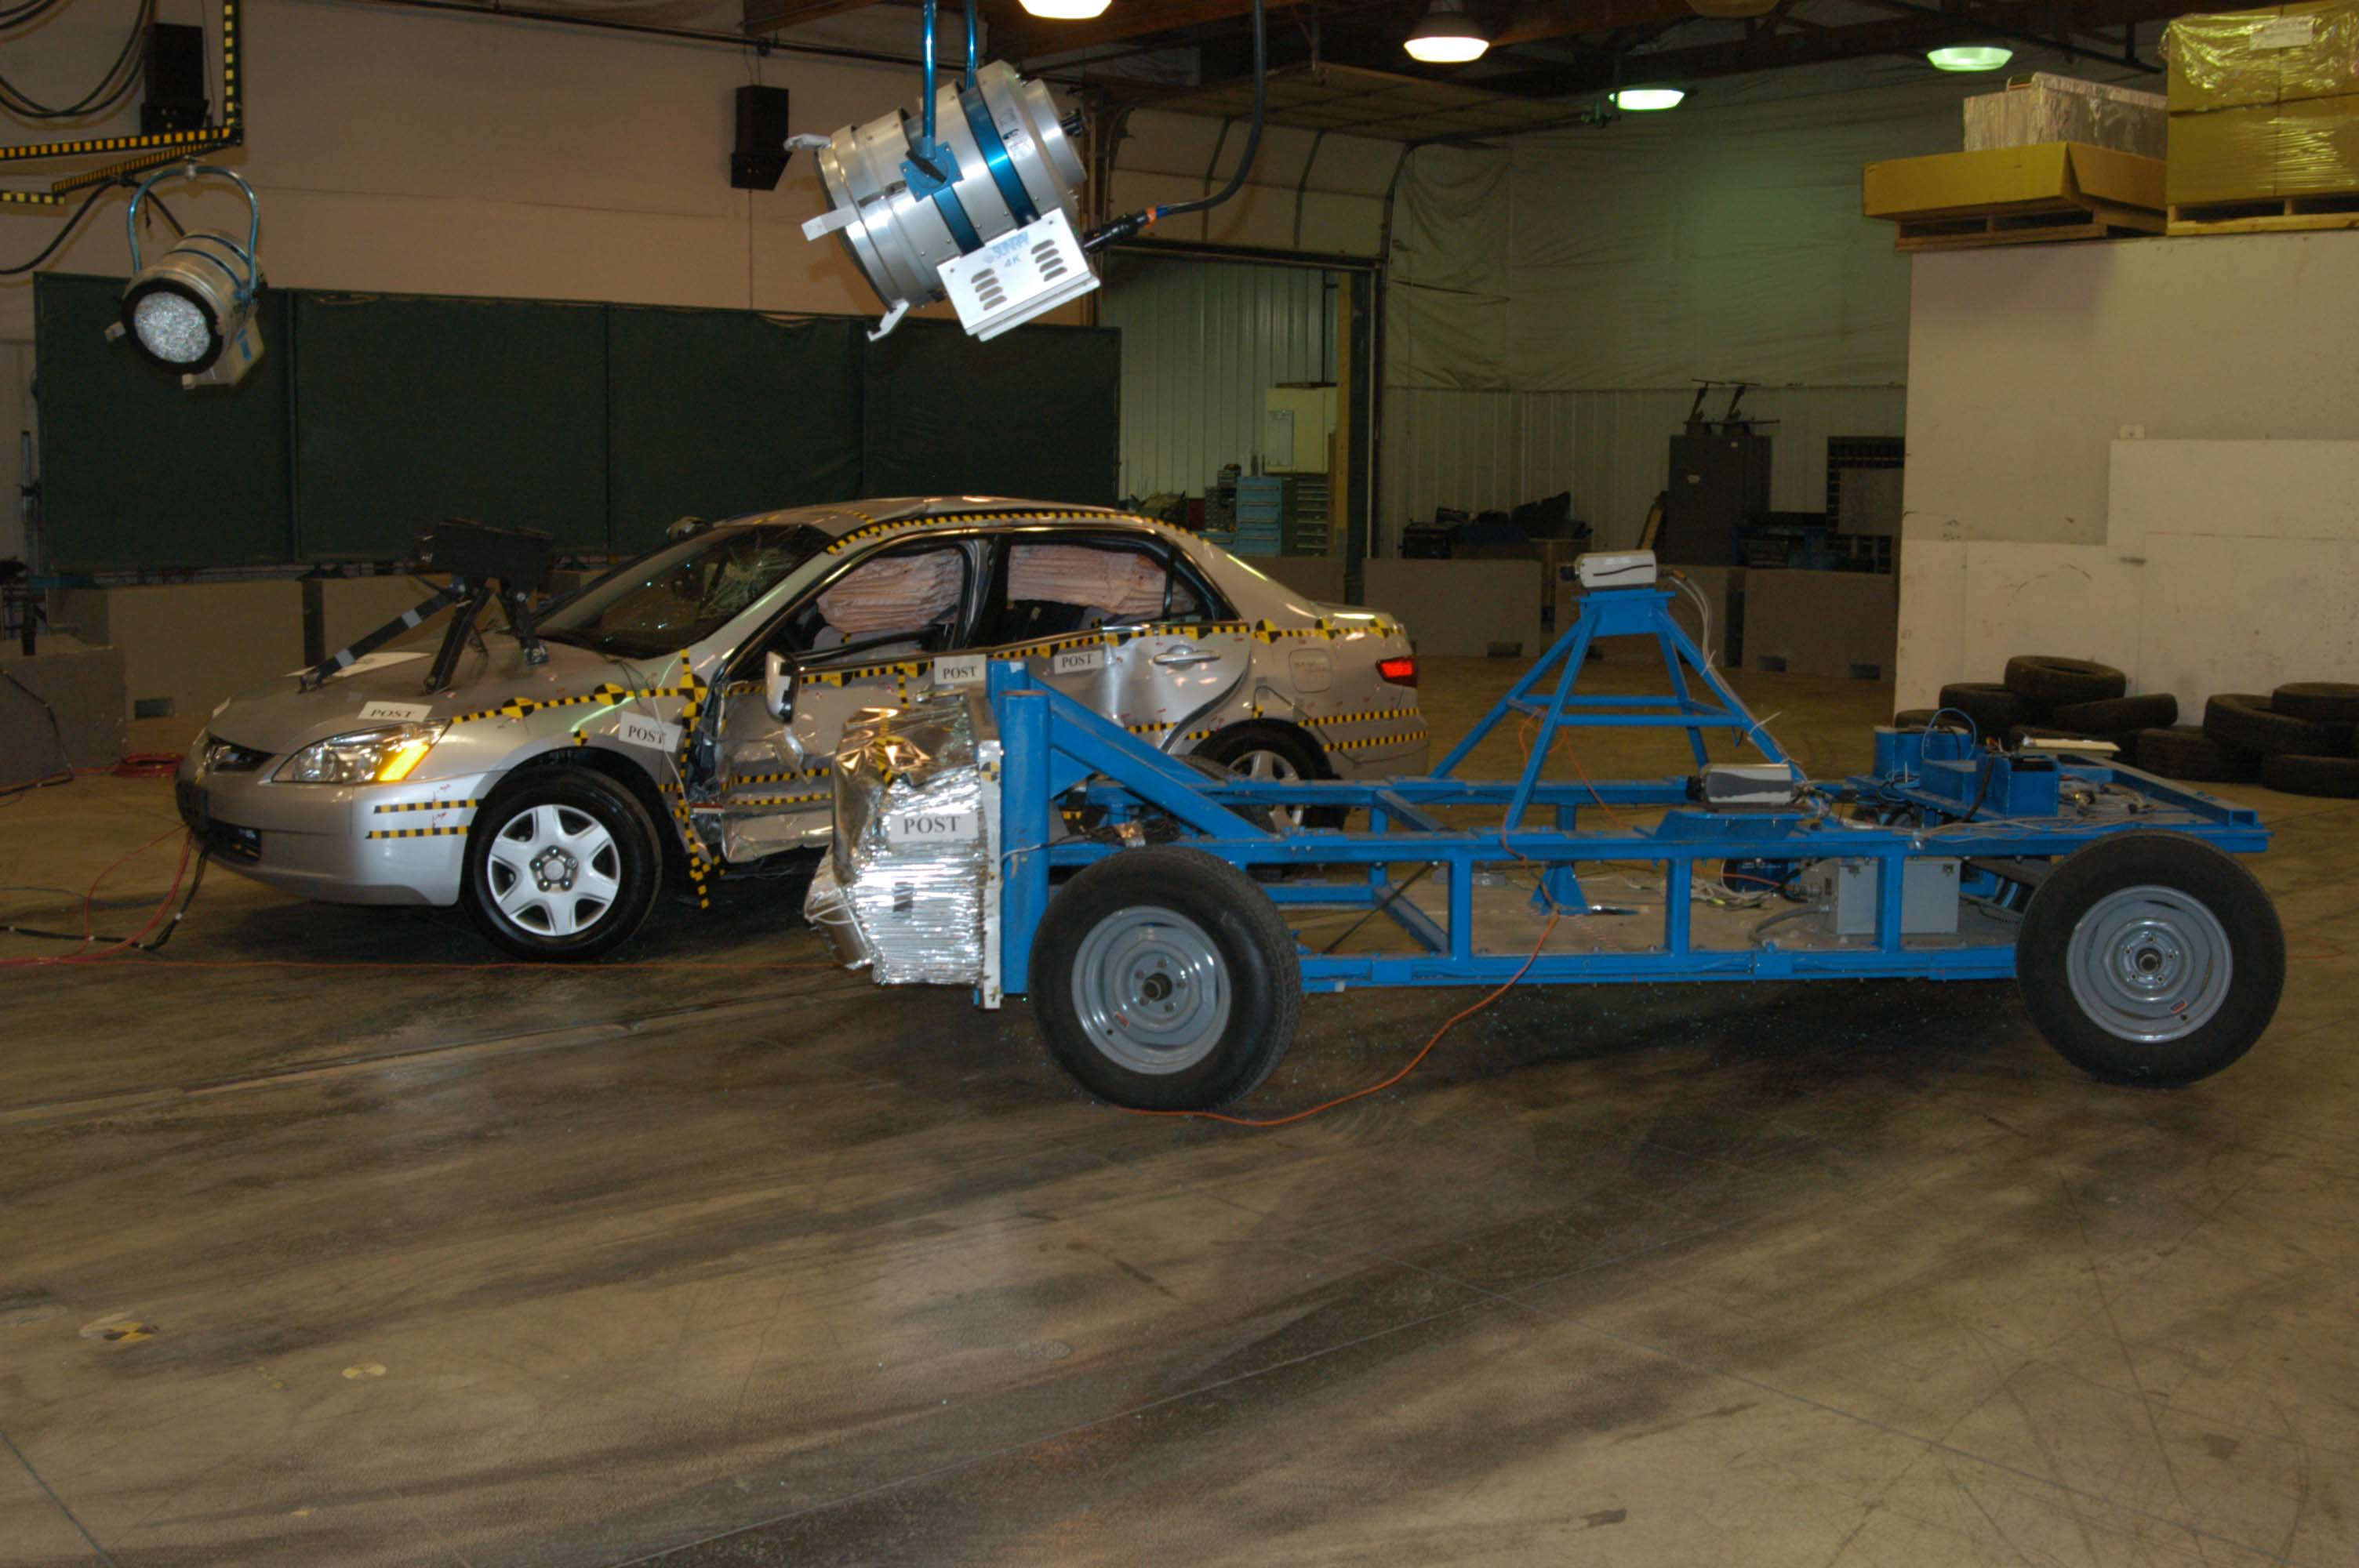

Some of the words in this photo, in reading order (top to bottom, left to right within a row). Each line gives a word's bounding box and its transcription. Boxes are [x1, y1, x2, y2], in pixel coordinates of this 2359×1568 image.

[1005, 255, 1022, 267] 4K
[1061, 653, 1092, 668] POST
[943, 665, 977, 680] POST
[369, 709, 416, 717] POST
[627, 724, 665, 745] POST
[903, 816, 960, 835] POST
